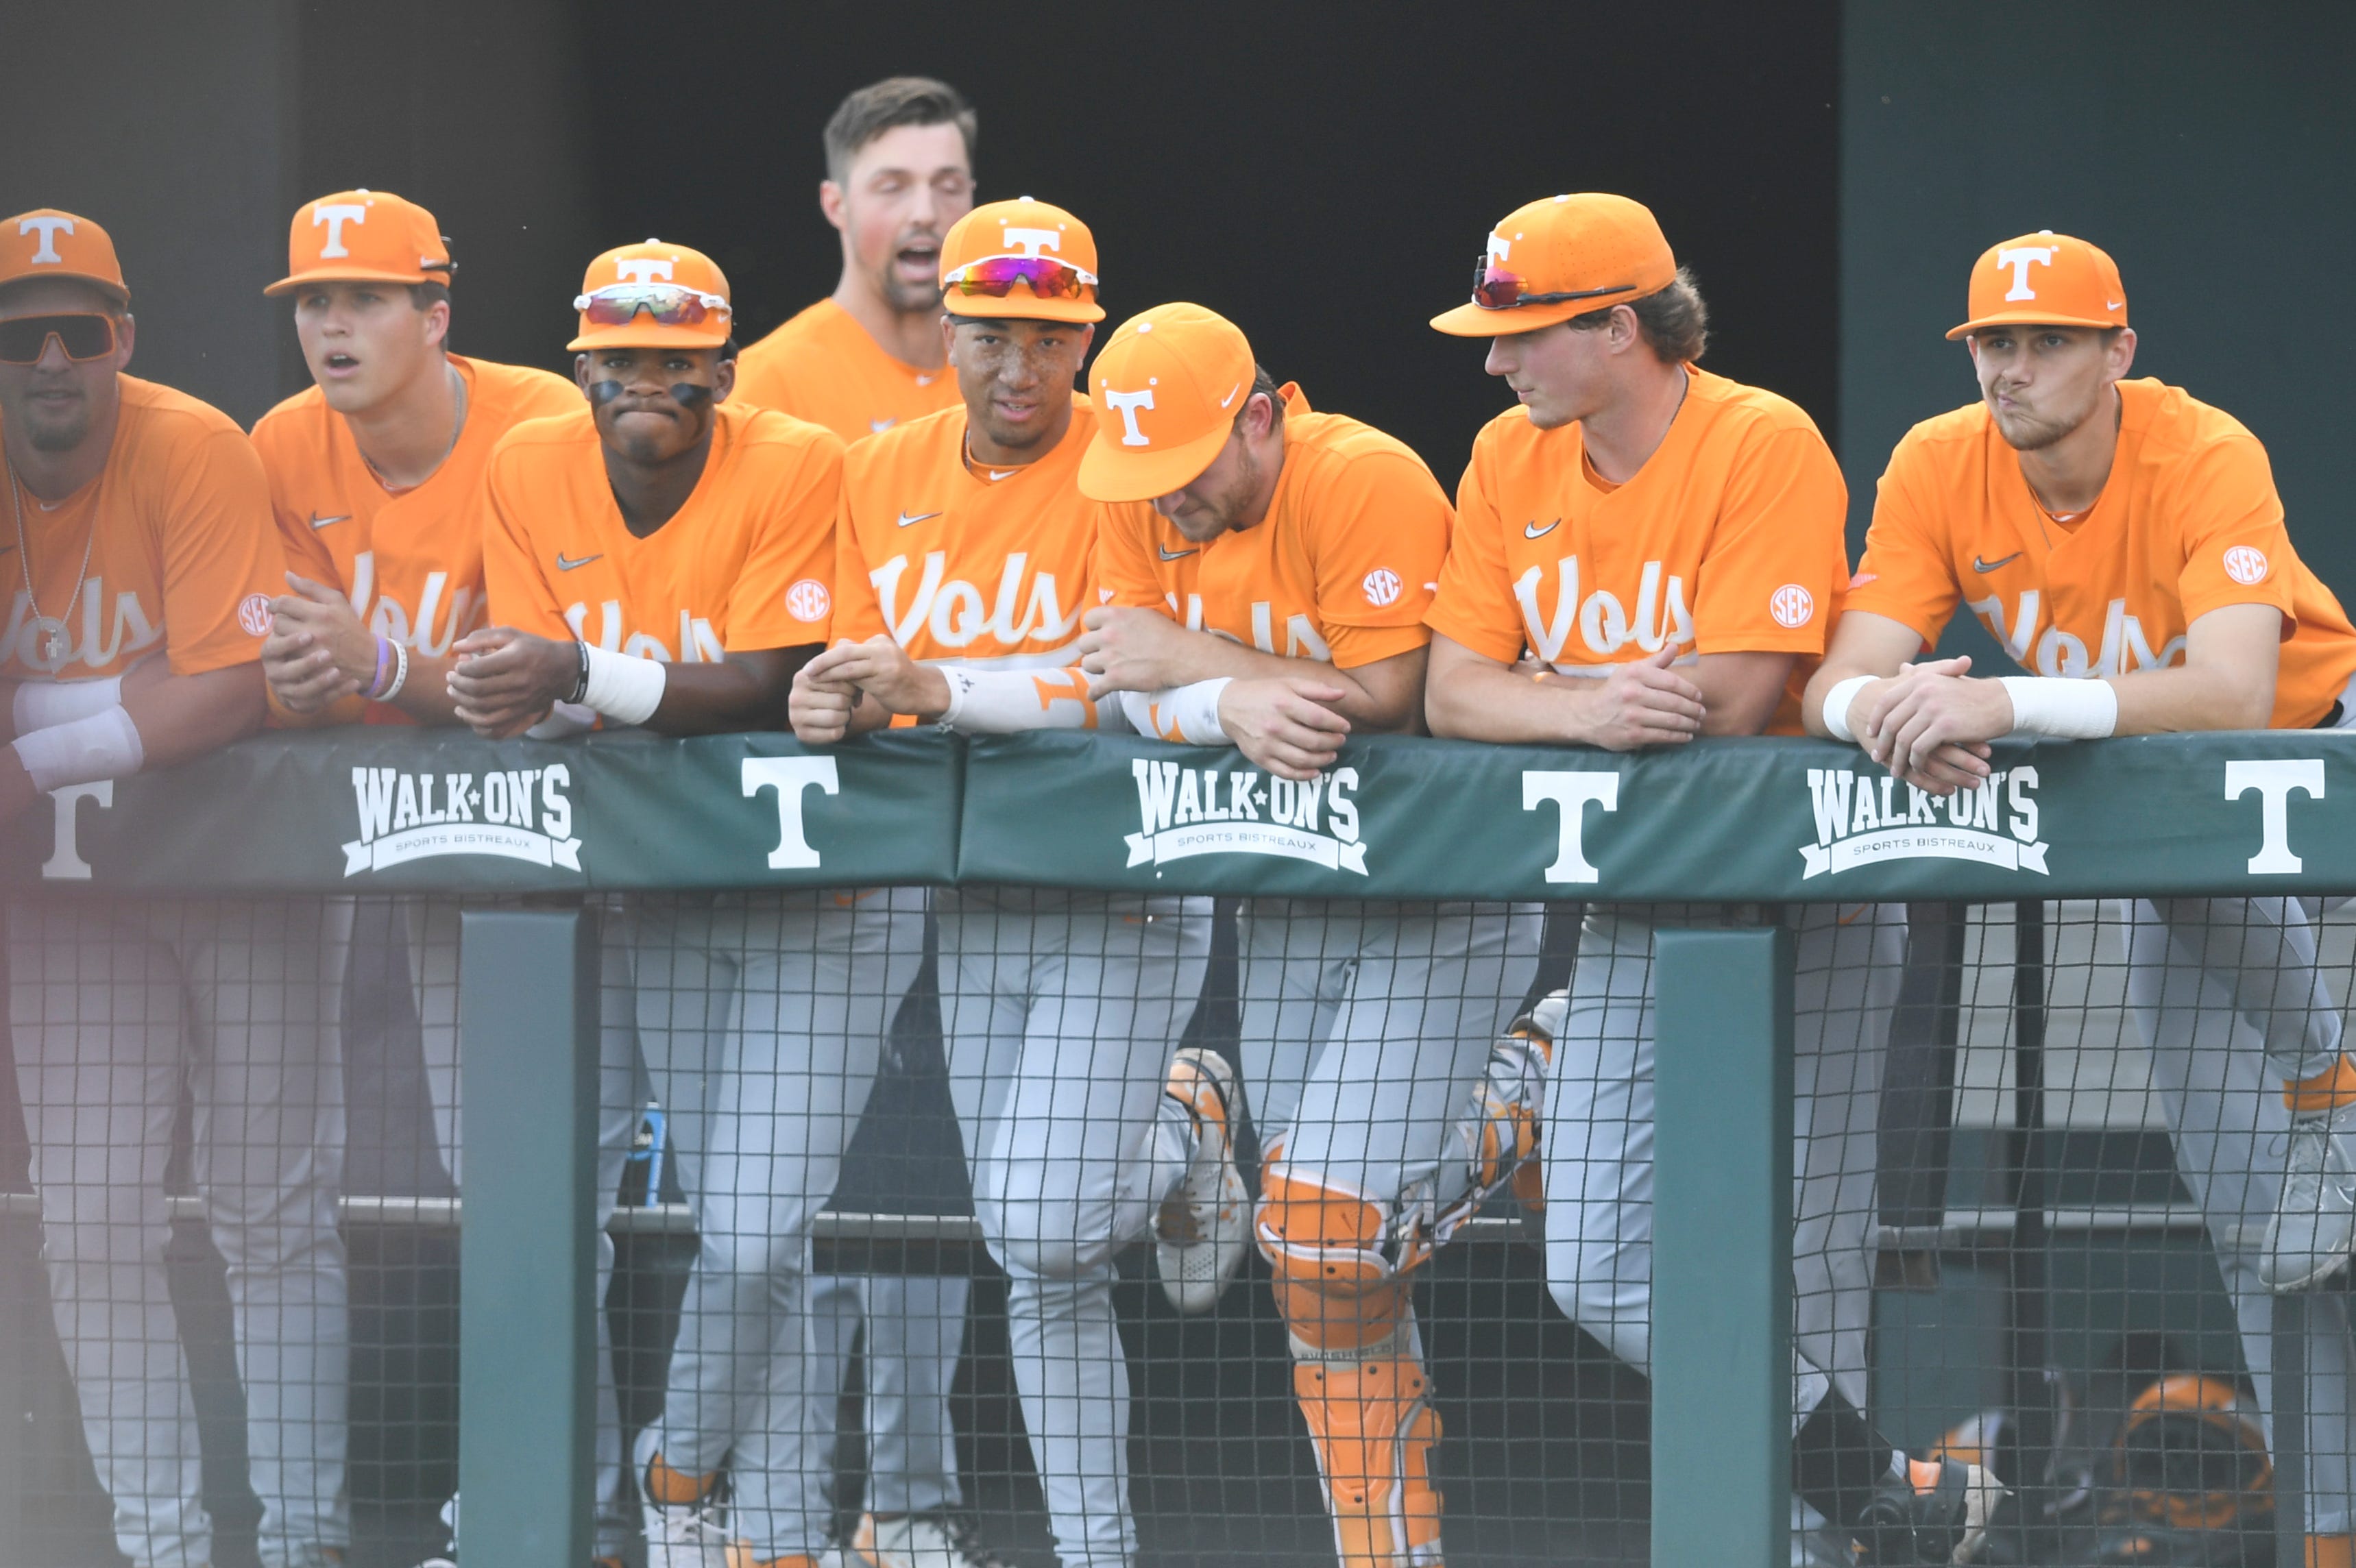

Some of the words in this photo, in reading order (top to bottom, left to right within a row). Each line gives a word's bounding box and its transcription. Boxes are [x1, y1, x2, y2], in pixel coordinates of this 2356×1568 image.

[20, 217, 75, 264] T
[313, 204, 366, 259] T
[1003, 228, 1060, 255] T
[617, 259, 673, 284] T
[1996, 247, 2052, 302] T
[1104, 389, 1155, 446] T
[1363, 569, 1400, 605] SEC
[2226, 549, 2264, 583] SEC
[789, 583, 825, 618] SEC
[869, 551, 1083, 648] Vols
[1512, 553, 1695, 662] Vols
[1774, 587, 1810, 625] SEC
[741, 755, 840, 869] T
[1522, 770, 1620, 883] T
[2224, 759, 2325, 874] T
[396, 835, 448, 853] SPORTS
[454, 833, 531, 849] BISTREAUX
[1177, 832, 1233, 848] SPORTS
[1238, 833, 1317, 852] BISTREAUX
[1853, 837, 1911, 856] SPORTS
[1917, 837, 1995, 854] BISTREAUX
